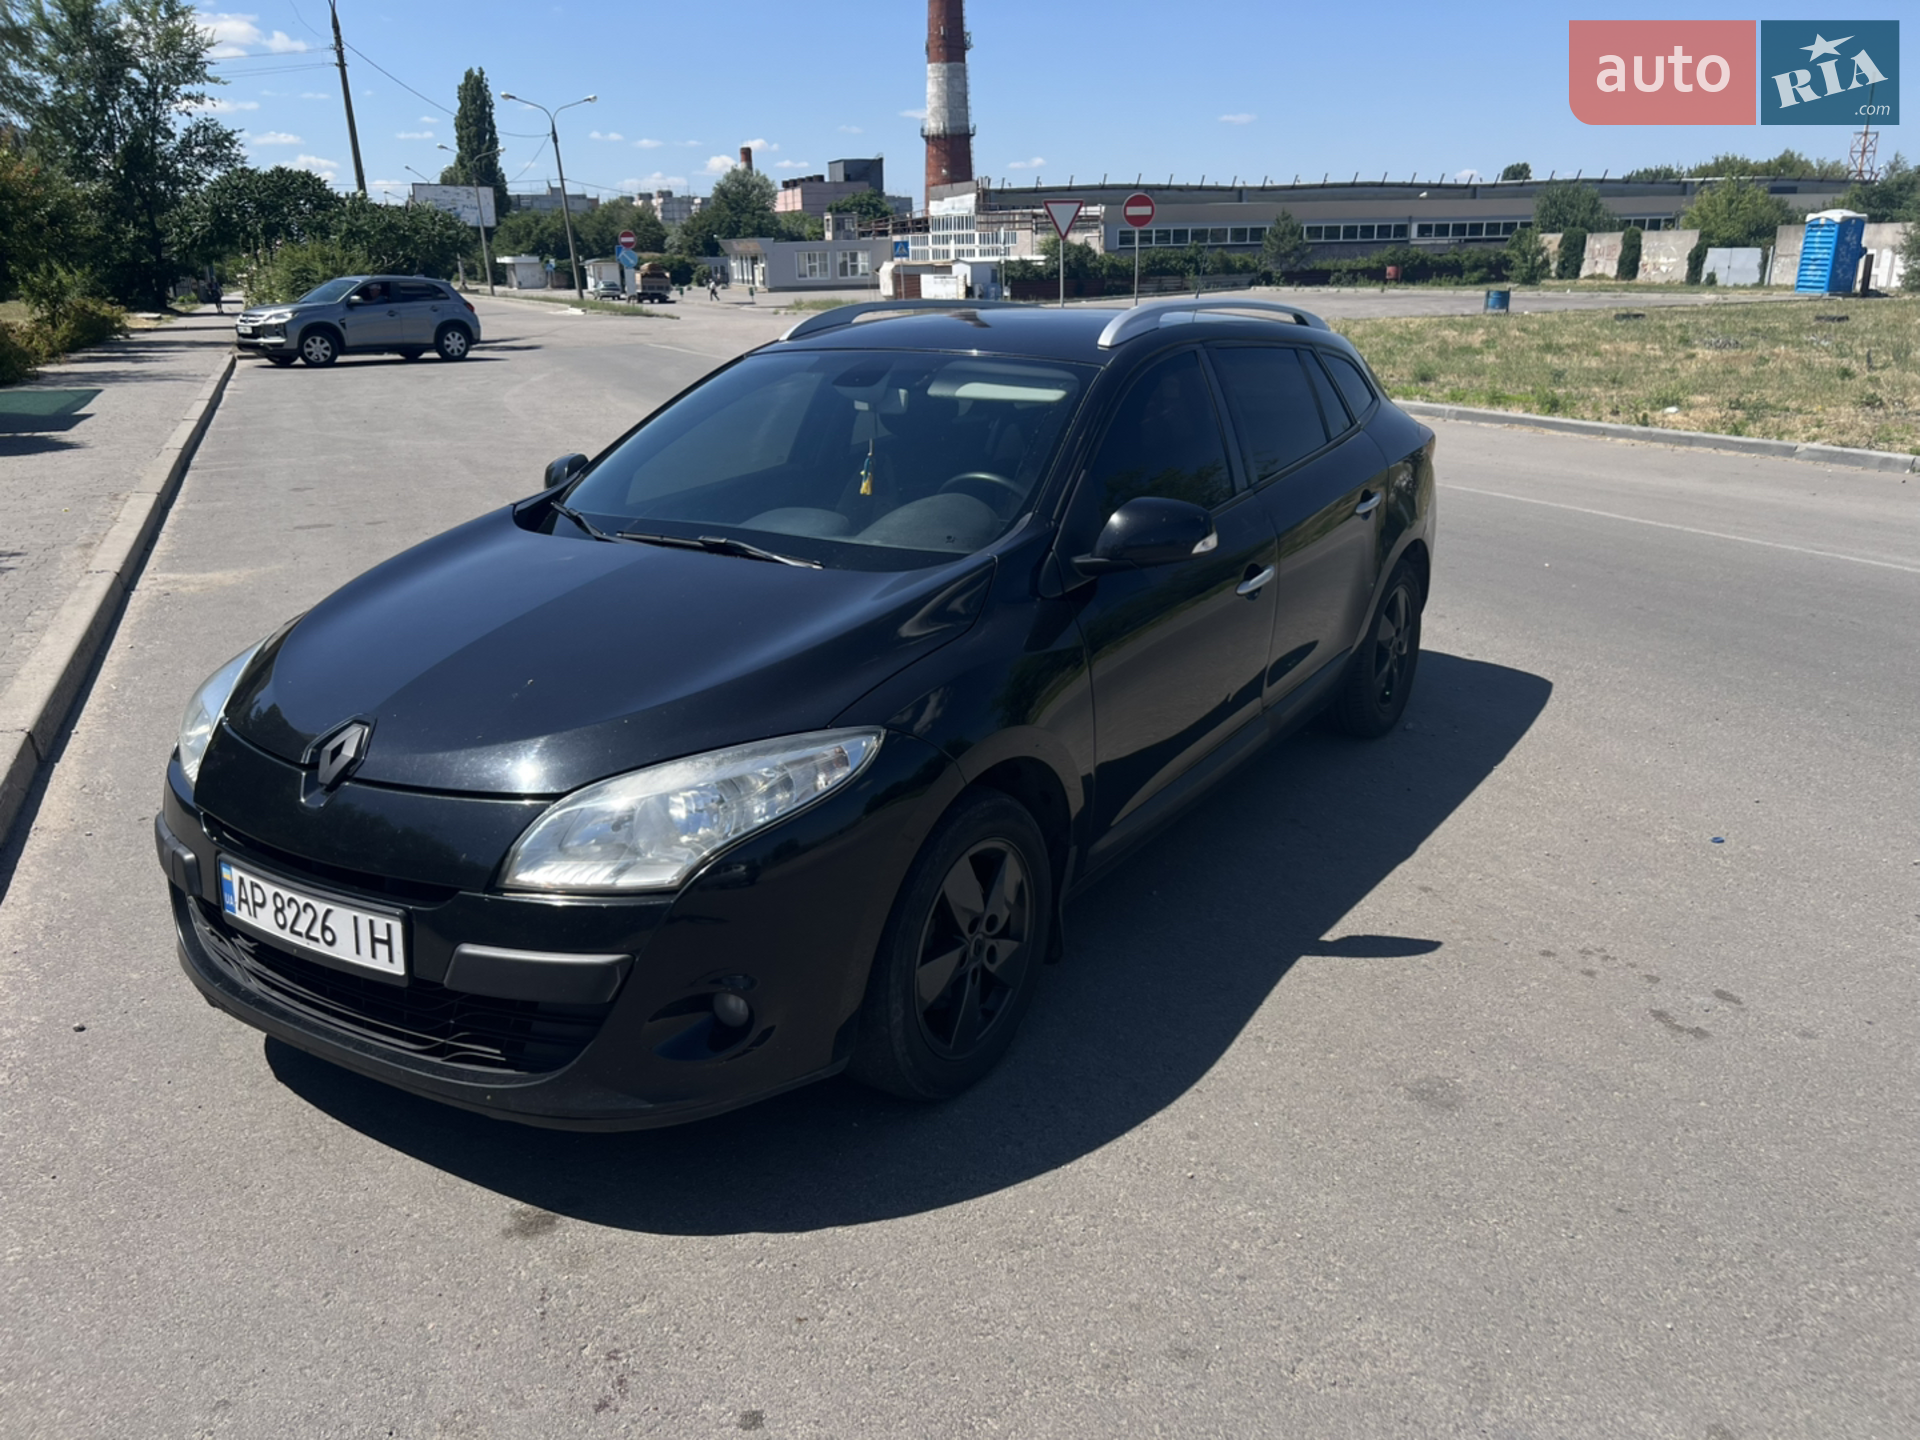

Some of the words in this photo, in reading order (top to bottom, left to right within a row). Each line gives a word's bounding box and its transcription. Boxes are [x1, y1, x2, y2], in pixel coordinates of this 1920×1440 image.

[224, 893, 235, 905] UA
[238, 875, 266, 919] AP
[272, 891, 337, 947] 8226
[353, 914, 394, 964] IH
